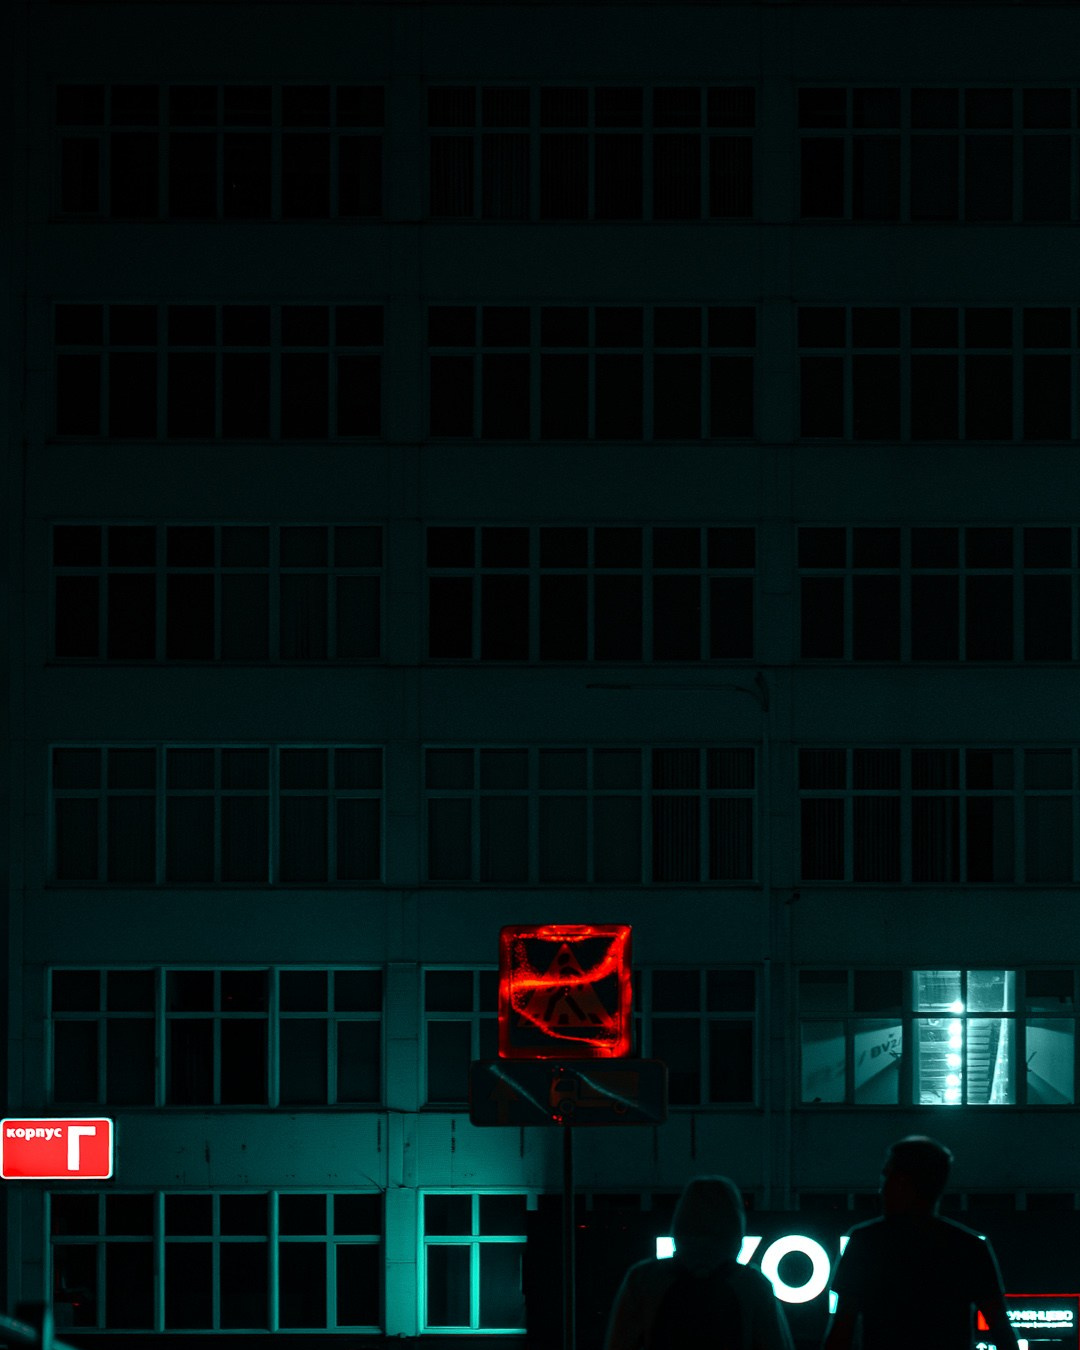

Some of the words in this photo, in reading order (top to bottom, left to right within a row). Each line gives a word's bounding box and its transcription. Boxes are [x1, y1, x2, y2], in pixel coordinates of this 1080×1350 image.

[6, 1127, 62, 1141] корпус
[67, 1126, 96, 1171] Г
[1005, 1310, 1073, 1321] УМЯНЦЕВО
